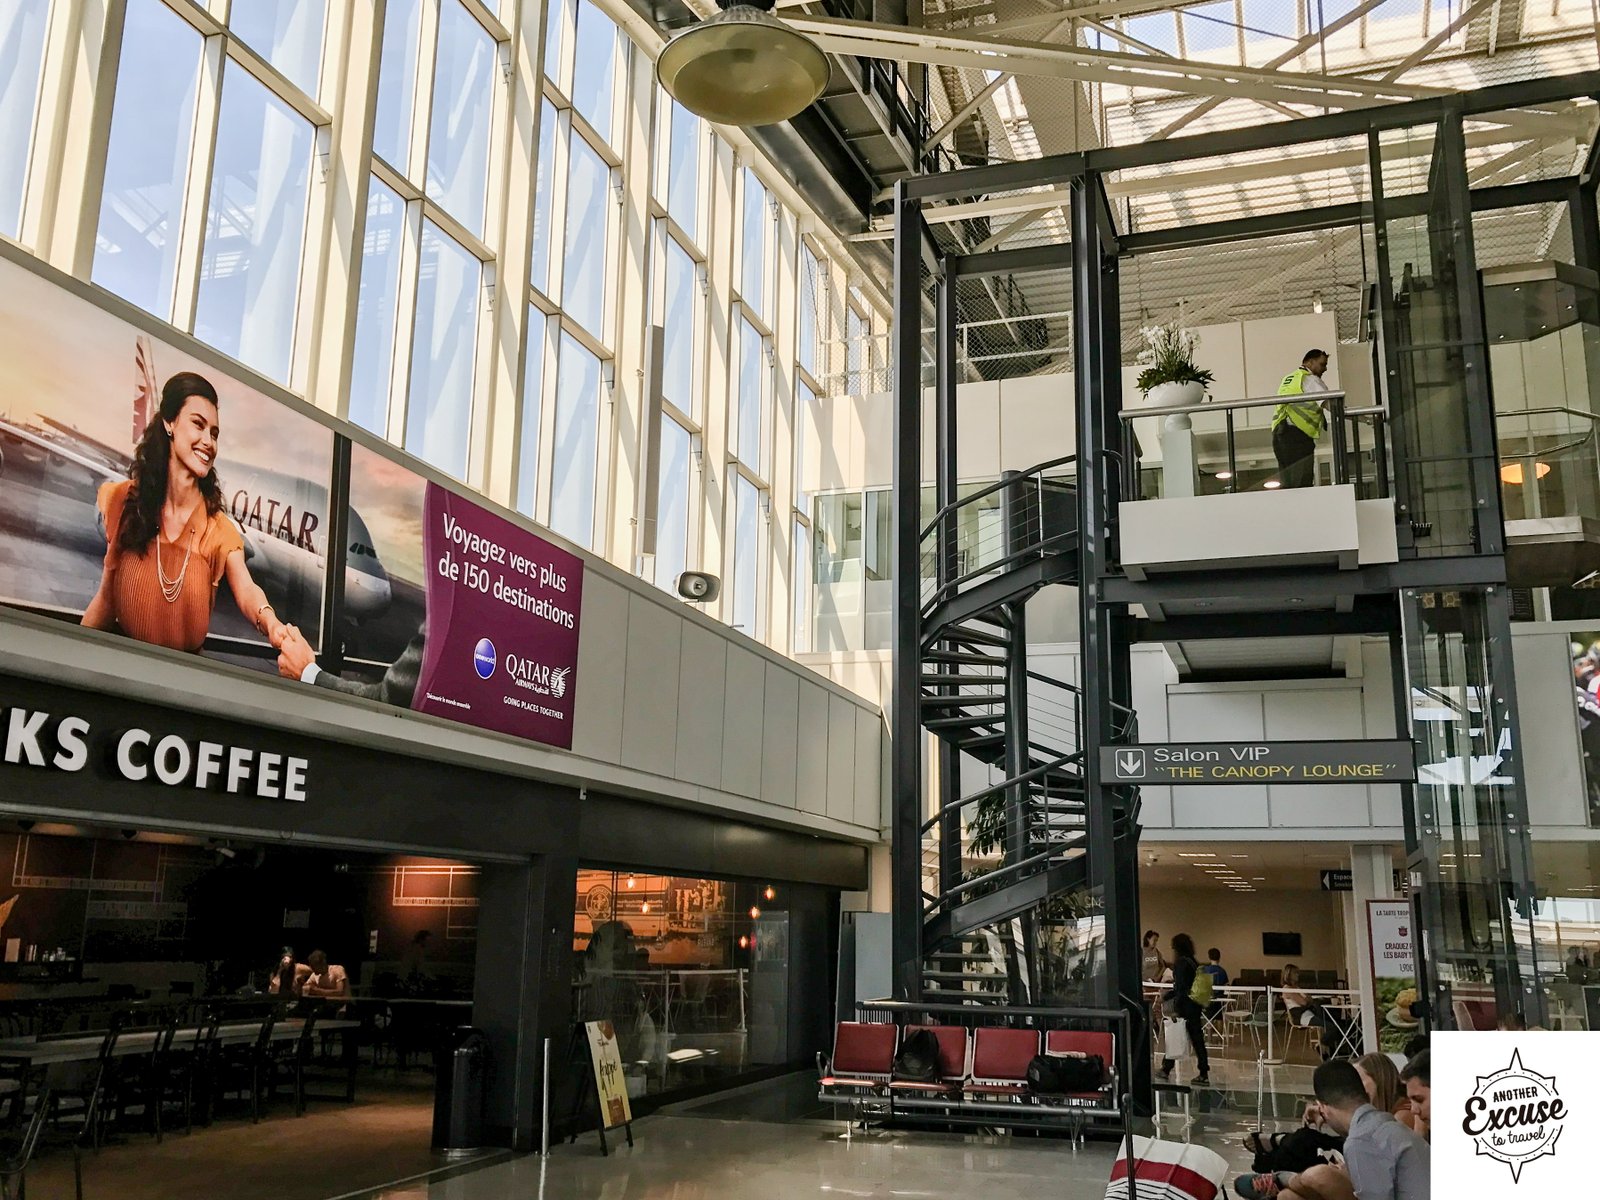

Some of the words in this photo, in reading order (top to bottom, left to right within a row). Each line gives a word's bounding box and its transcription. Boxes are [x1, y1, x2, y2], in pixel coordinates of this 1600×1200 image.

[231, 489, 319, 554] QATAR
[443, 512, 506, 563] Voyagez
[509, 551, 537, 579] vers
[540, 563, 567, 593] plus
[438, 551, 459, 581] de
[463, 561, 490, 594] 150
[493, 574, 574, 630] destinations
[505, 653, 550, 687] QATAR
[503, 695, 521, 708] GOING
[521, 700, 539, 713] PLACES
[539, 706, 564, 720] TOGETHER
[117, 728, 308, 801] COFFEE
[1153, 747, 1219, 762] Salon
[1229, 746, 1270, 762] VIP
[1211, 764, 1295, 778] CANOPY
[1383, 951, 1393, 959] LES
[1394, 951, 1408, 959] BABY
[1385, 942, 1408, 950] CRAQUEZ
